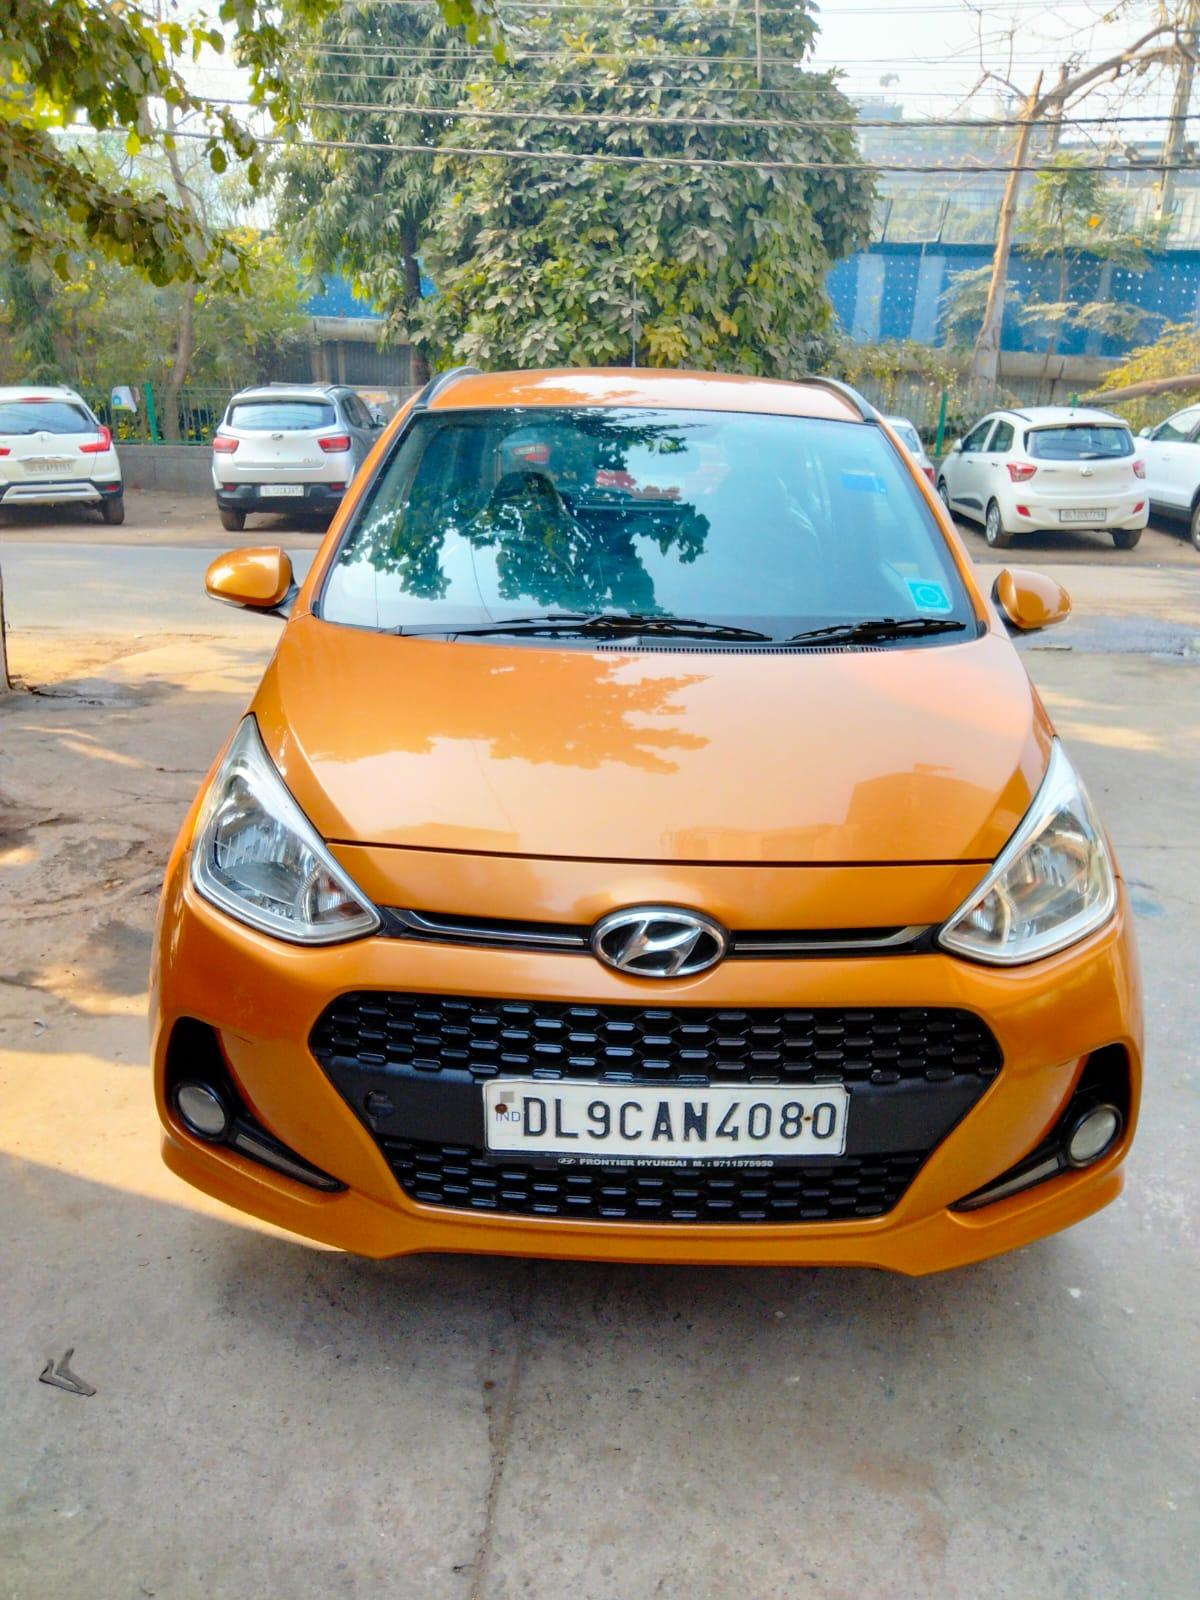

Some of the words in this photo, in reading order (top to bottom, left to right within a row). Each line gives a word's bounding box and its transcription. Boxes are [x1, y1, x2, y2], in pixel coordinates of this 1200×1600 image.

[496, 1111, 521, 1121] IND
[523, 1097, 837, 1141] DL9CAN4080
[637, 1159, 687, 1167] HYUNDAI
